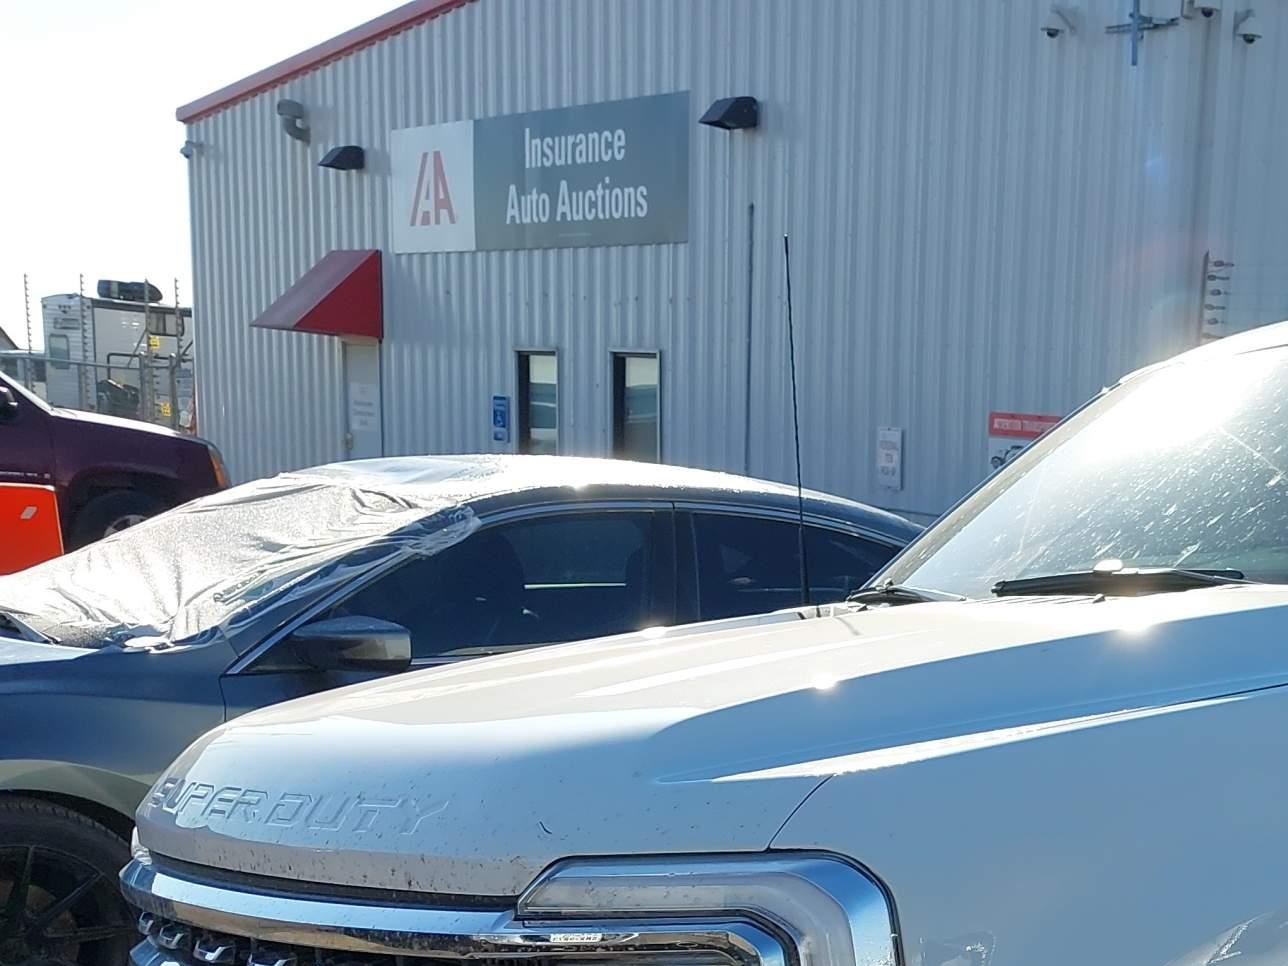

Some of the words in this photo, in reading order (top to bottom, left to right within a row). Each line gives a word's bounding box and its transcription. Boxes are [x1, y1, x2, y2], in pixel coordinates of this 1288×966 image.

[524, 127, 627, 169] Insurance
[505, 183, 550, 225] Auto
[555, 176, 649, 222] Auctions
[149, 775, 269, 823] SUPER
[264, 790, 448, 836] DUTY
